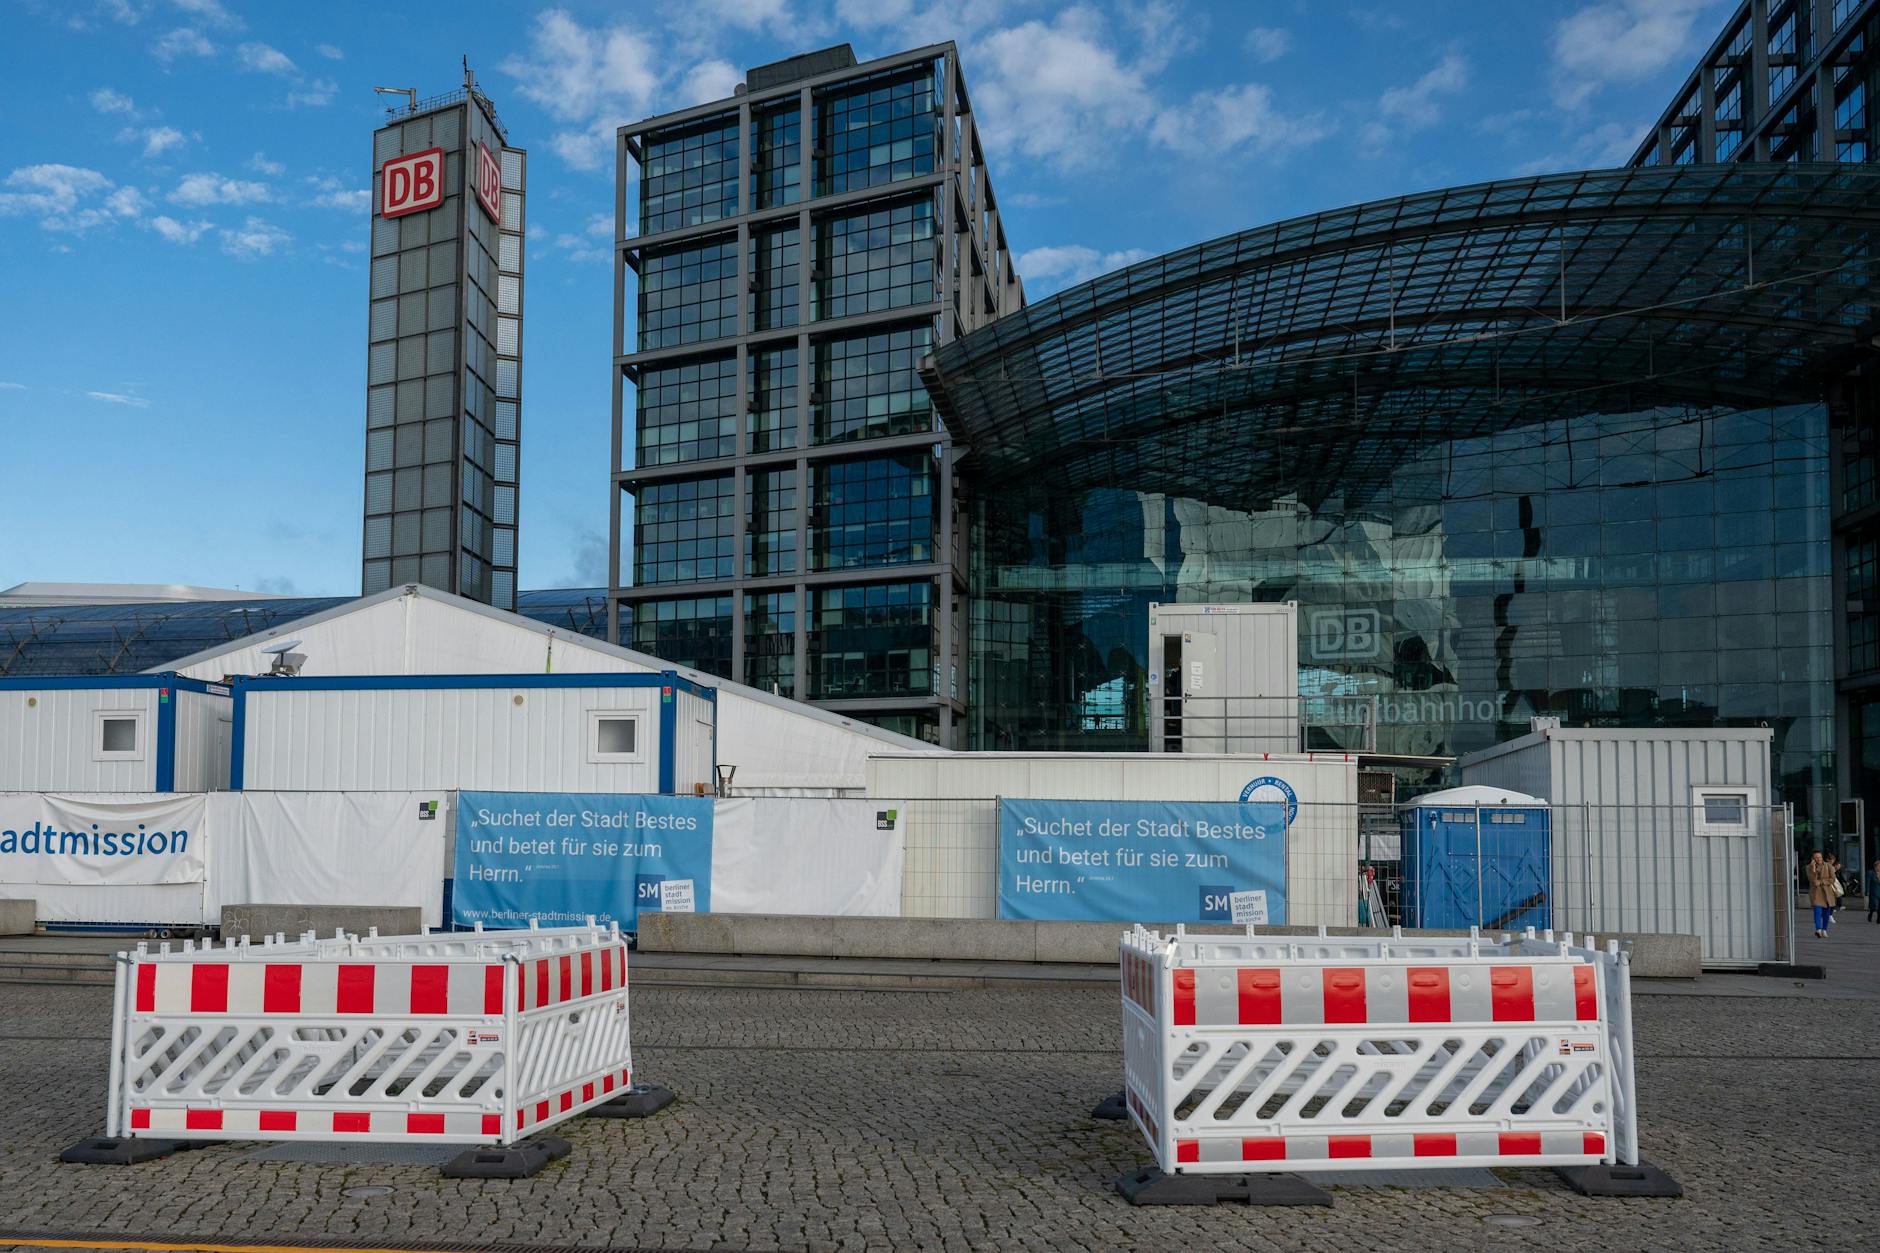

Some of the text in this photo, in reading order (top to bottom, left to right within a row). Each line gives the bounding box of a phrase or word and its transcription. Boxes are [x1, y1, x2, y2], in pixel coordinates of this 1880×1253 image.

[389, 160, 434, 207] DB
[480, 155, 499, 210] DB
[1319, 616, 1372, 651] DB
[471, 809, 697, 830] „Suchet der Stadt Bestes
[1016, 817, 1266, 840] „Suchet der Stadt Bestes
[0, 821, 188, 856] adtmission
[470, 836, 662, 857] und betet für sie zum
[1016, 846, 1229, 868] und betet für sie zum
[638, 882, 659, 898] SM
[664, 891, 682, 899] stadt
[1234, 895, 1262, 904] berliner
[1204, 895, 1228, 911] SM
[1236, 910, 1264, 918] mission
